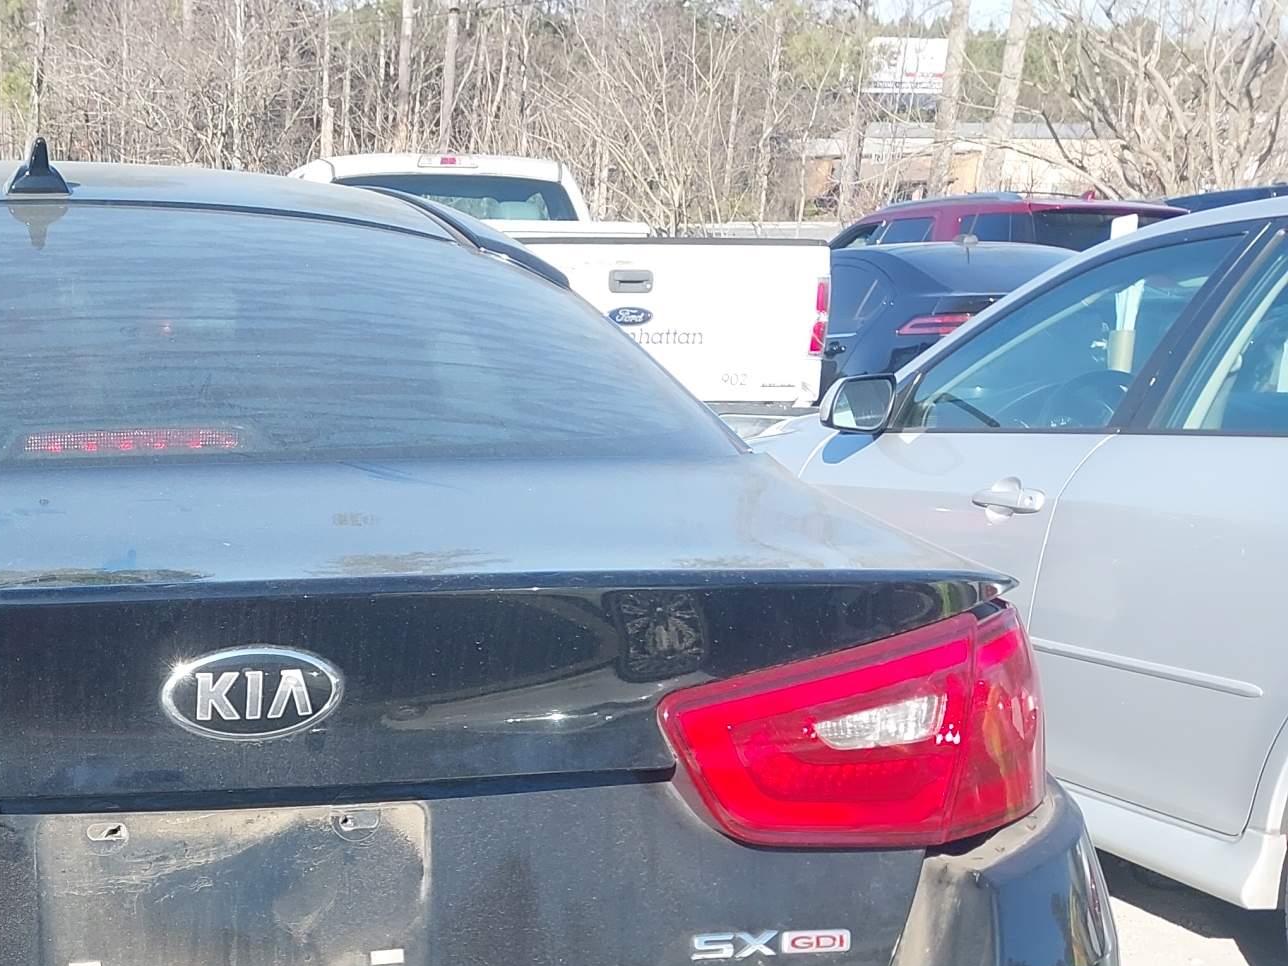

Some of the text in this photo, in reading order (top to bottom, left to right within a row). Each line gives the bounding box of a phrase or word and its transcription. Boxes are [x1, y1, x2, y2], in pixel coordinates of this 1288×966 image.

[195, 668, 313, 721] KIA
[690, 929, 845, 961] SX GDI
